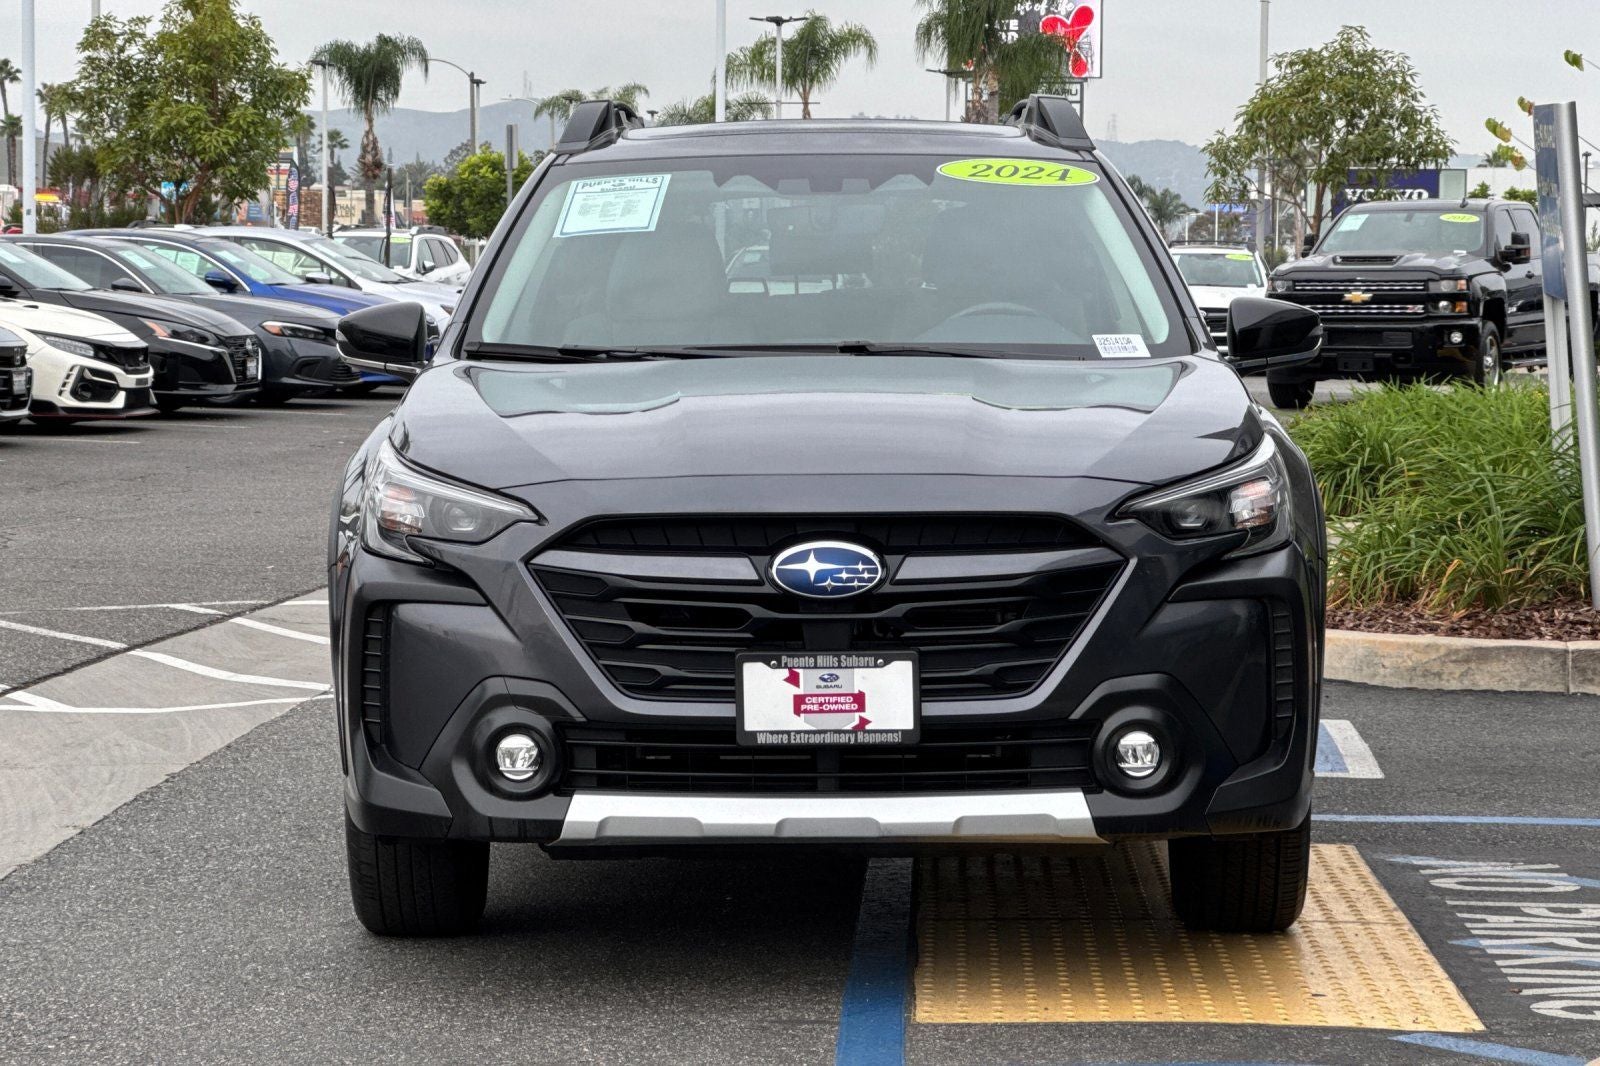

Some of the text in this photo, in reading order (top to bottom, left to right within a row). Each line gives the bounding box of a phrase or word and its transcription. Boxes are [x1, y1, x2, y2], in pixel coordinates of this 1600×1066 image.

[967, 163, 1072, 182] 2024
[1345, 188, 1429, 201] VOVO
[781, 655, 875, 668] Puente Hills Subaru
[756, 731, 902, 745] Where Extraordinary Happens!
